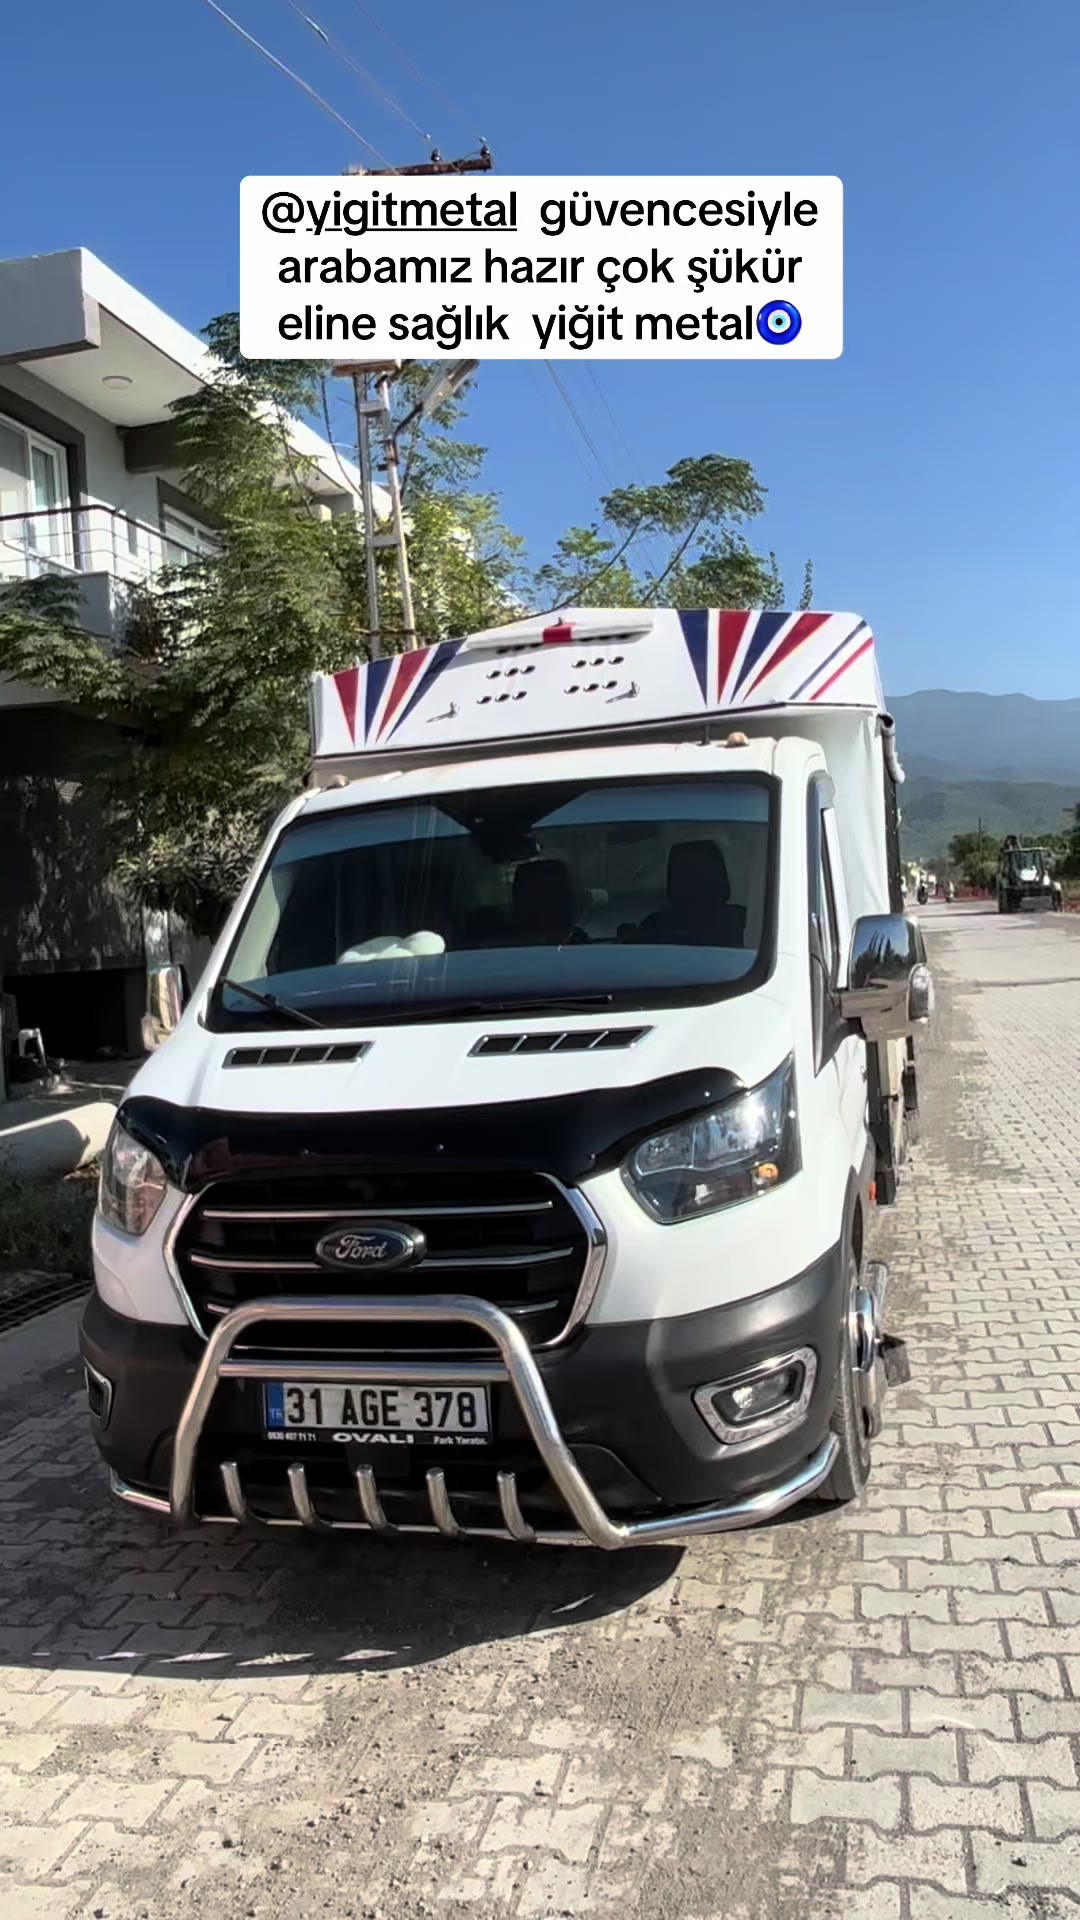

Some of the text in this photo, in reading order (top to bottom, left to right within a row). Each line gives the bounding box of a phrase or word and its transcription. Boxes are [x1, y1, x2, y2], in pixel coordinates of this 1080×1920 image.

[335, 1234, 388, 1259] Ford
[286, 1387, 477, 1429] 31 AGE 378
[332, 1432, 414, 1444] OVALI
